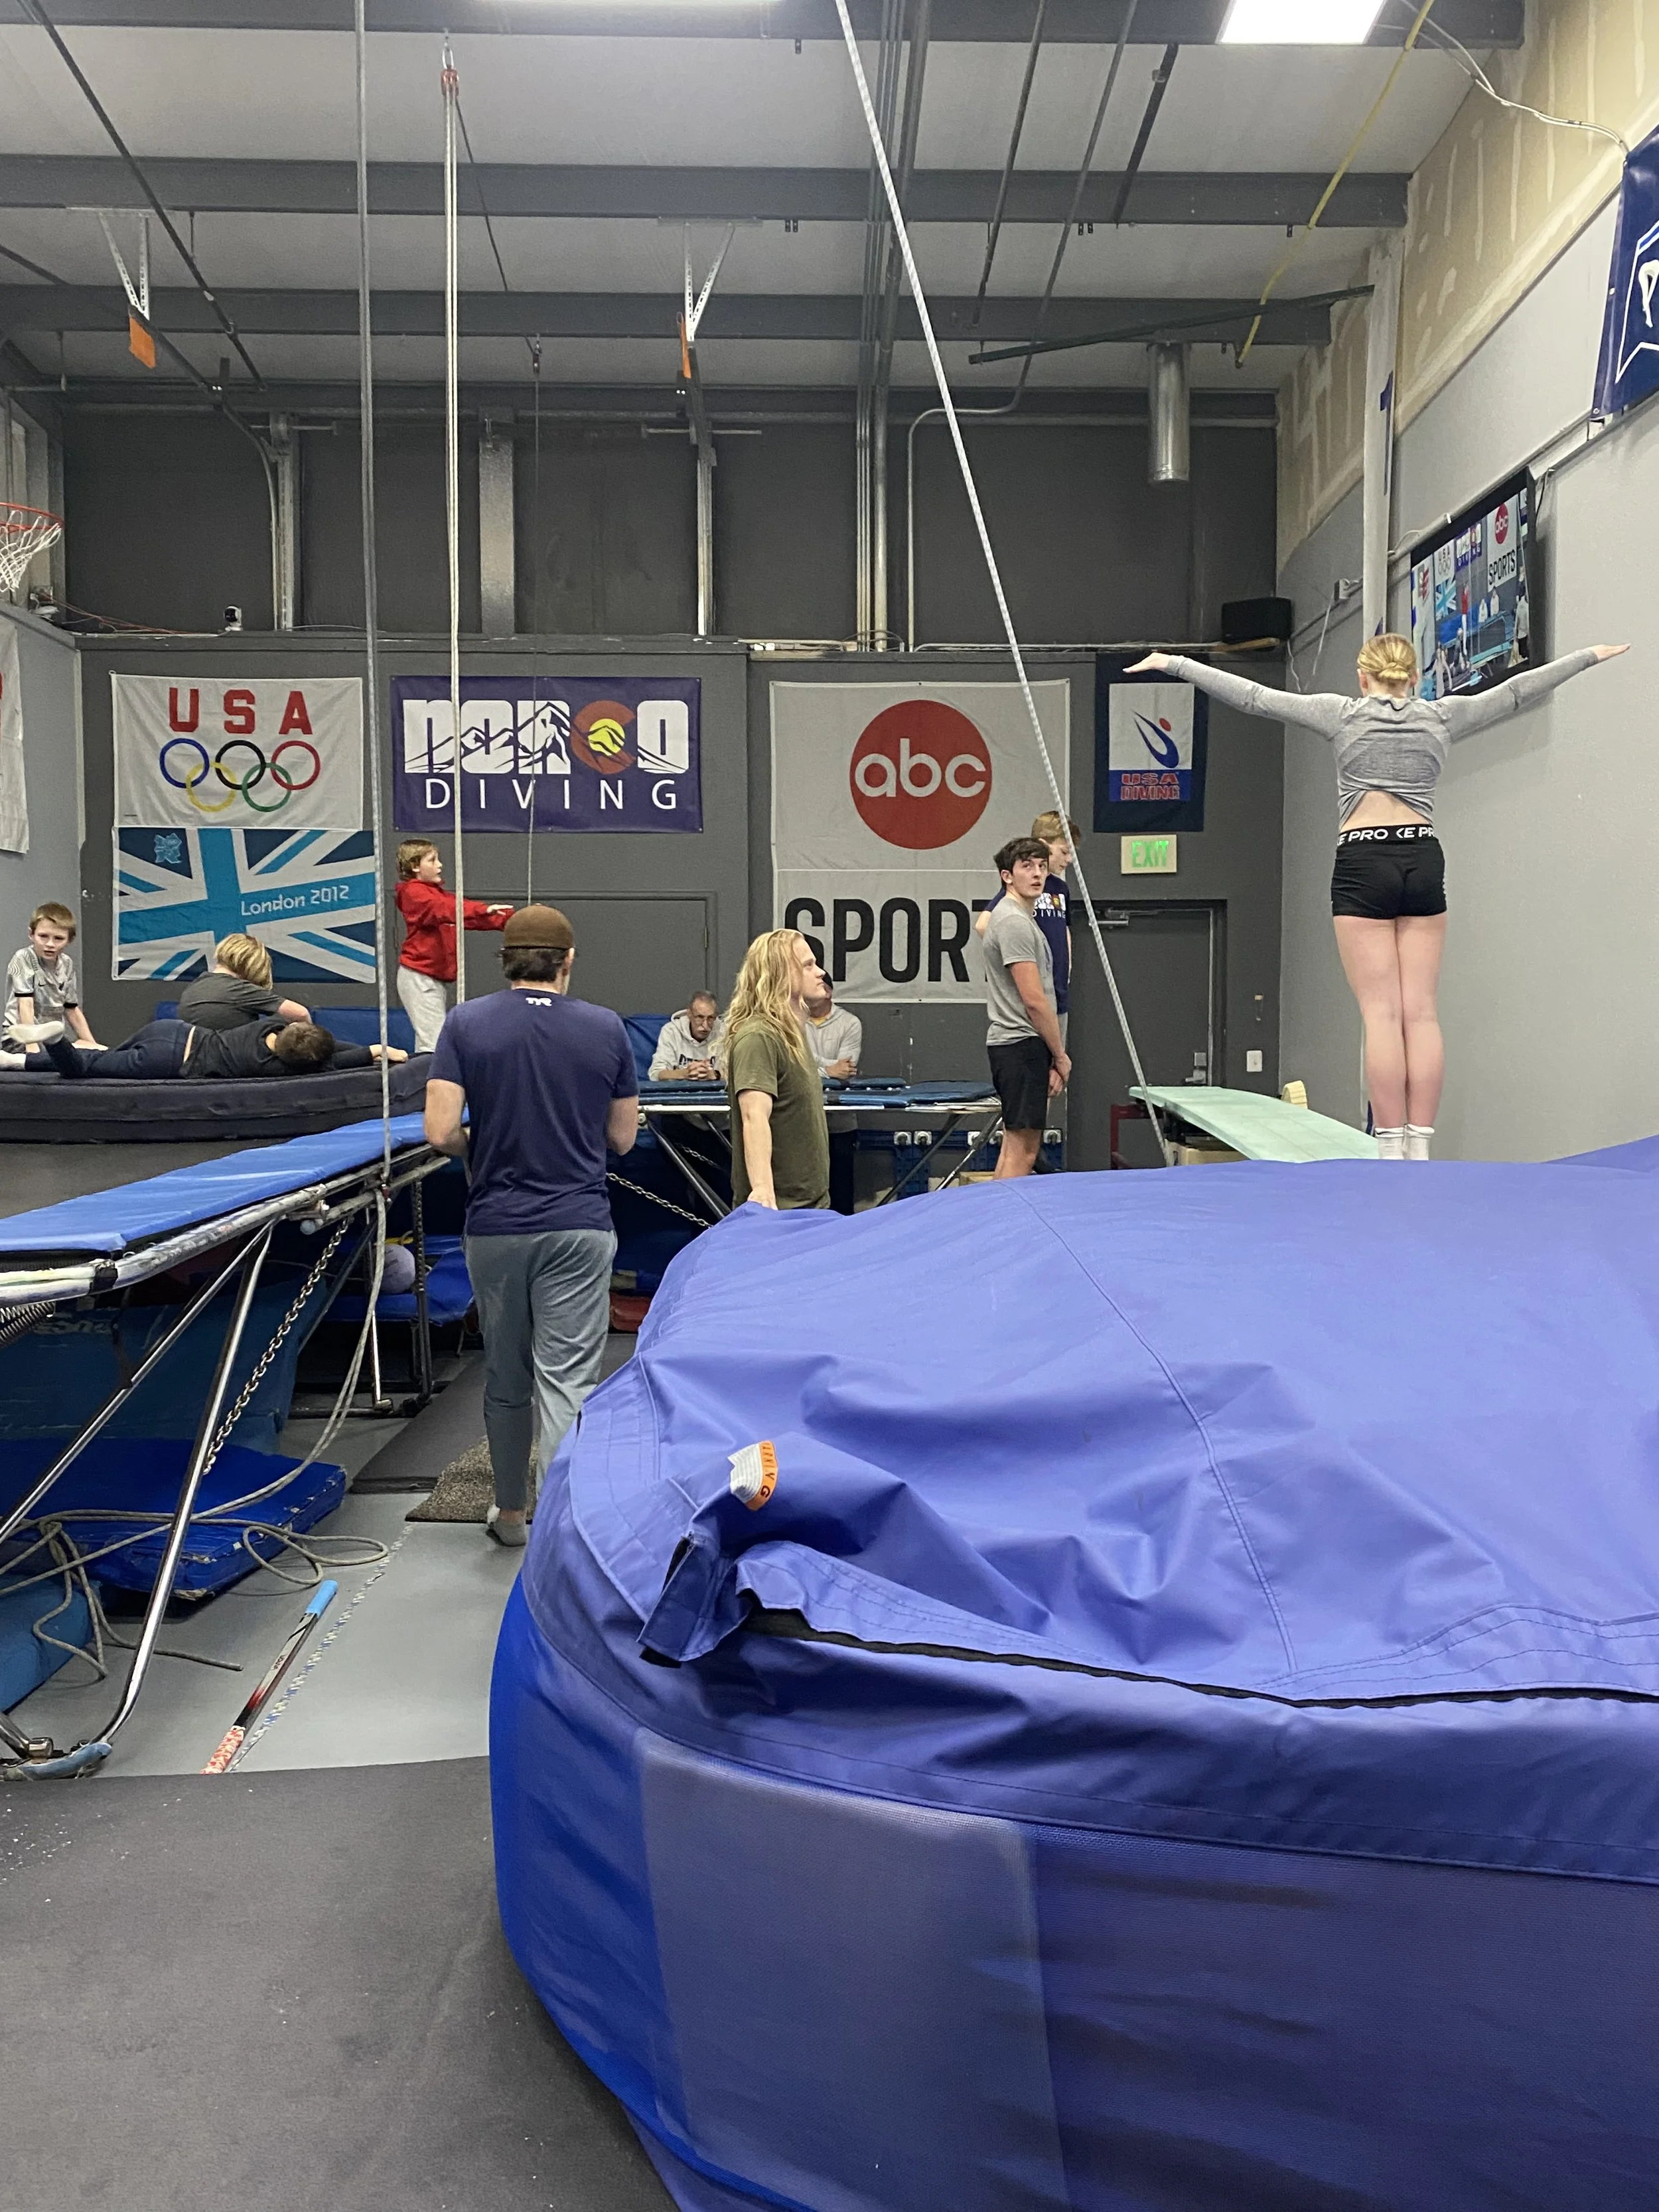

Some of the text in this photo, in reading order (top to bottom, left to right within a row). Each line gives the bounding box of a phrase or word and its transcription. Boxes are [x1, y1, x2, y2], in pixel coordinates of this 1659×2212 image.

[1488, 549, 1515, 585] SPORTS
[169, 687, 313, 735] USA
[855, 738, 986, 797] abc
[1121, 773, 1179, 786] USA
[425, 779, 677, 810] DIVING
[1121, 785, 1180, 800] DIVING
[1348, 829, 1389, 842] PRO
[1131, 840, 1169, 868] EXIT
[241, 885, 350, 916] London 2012
